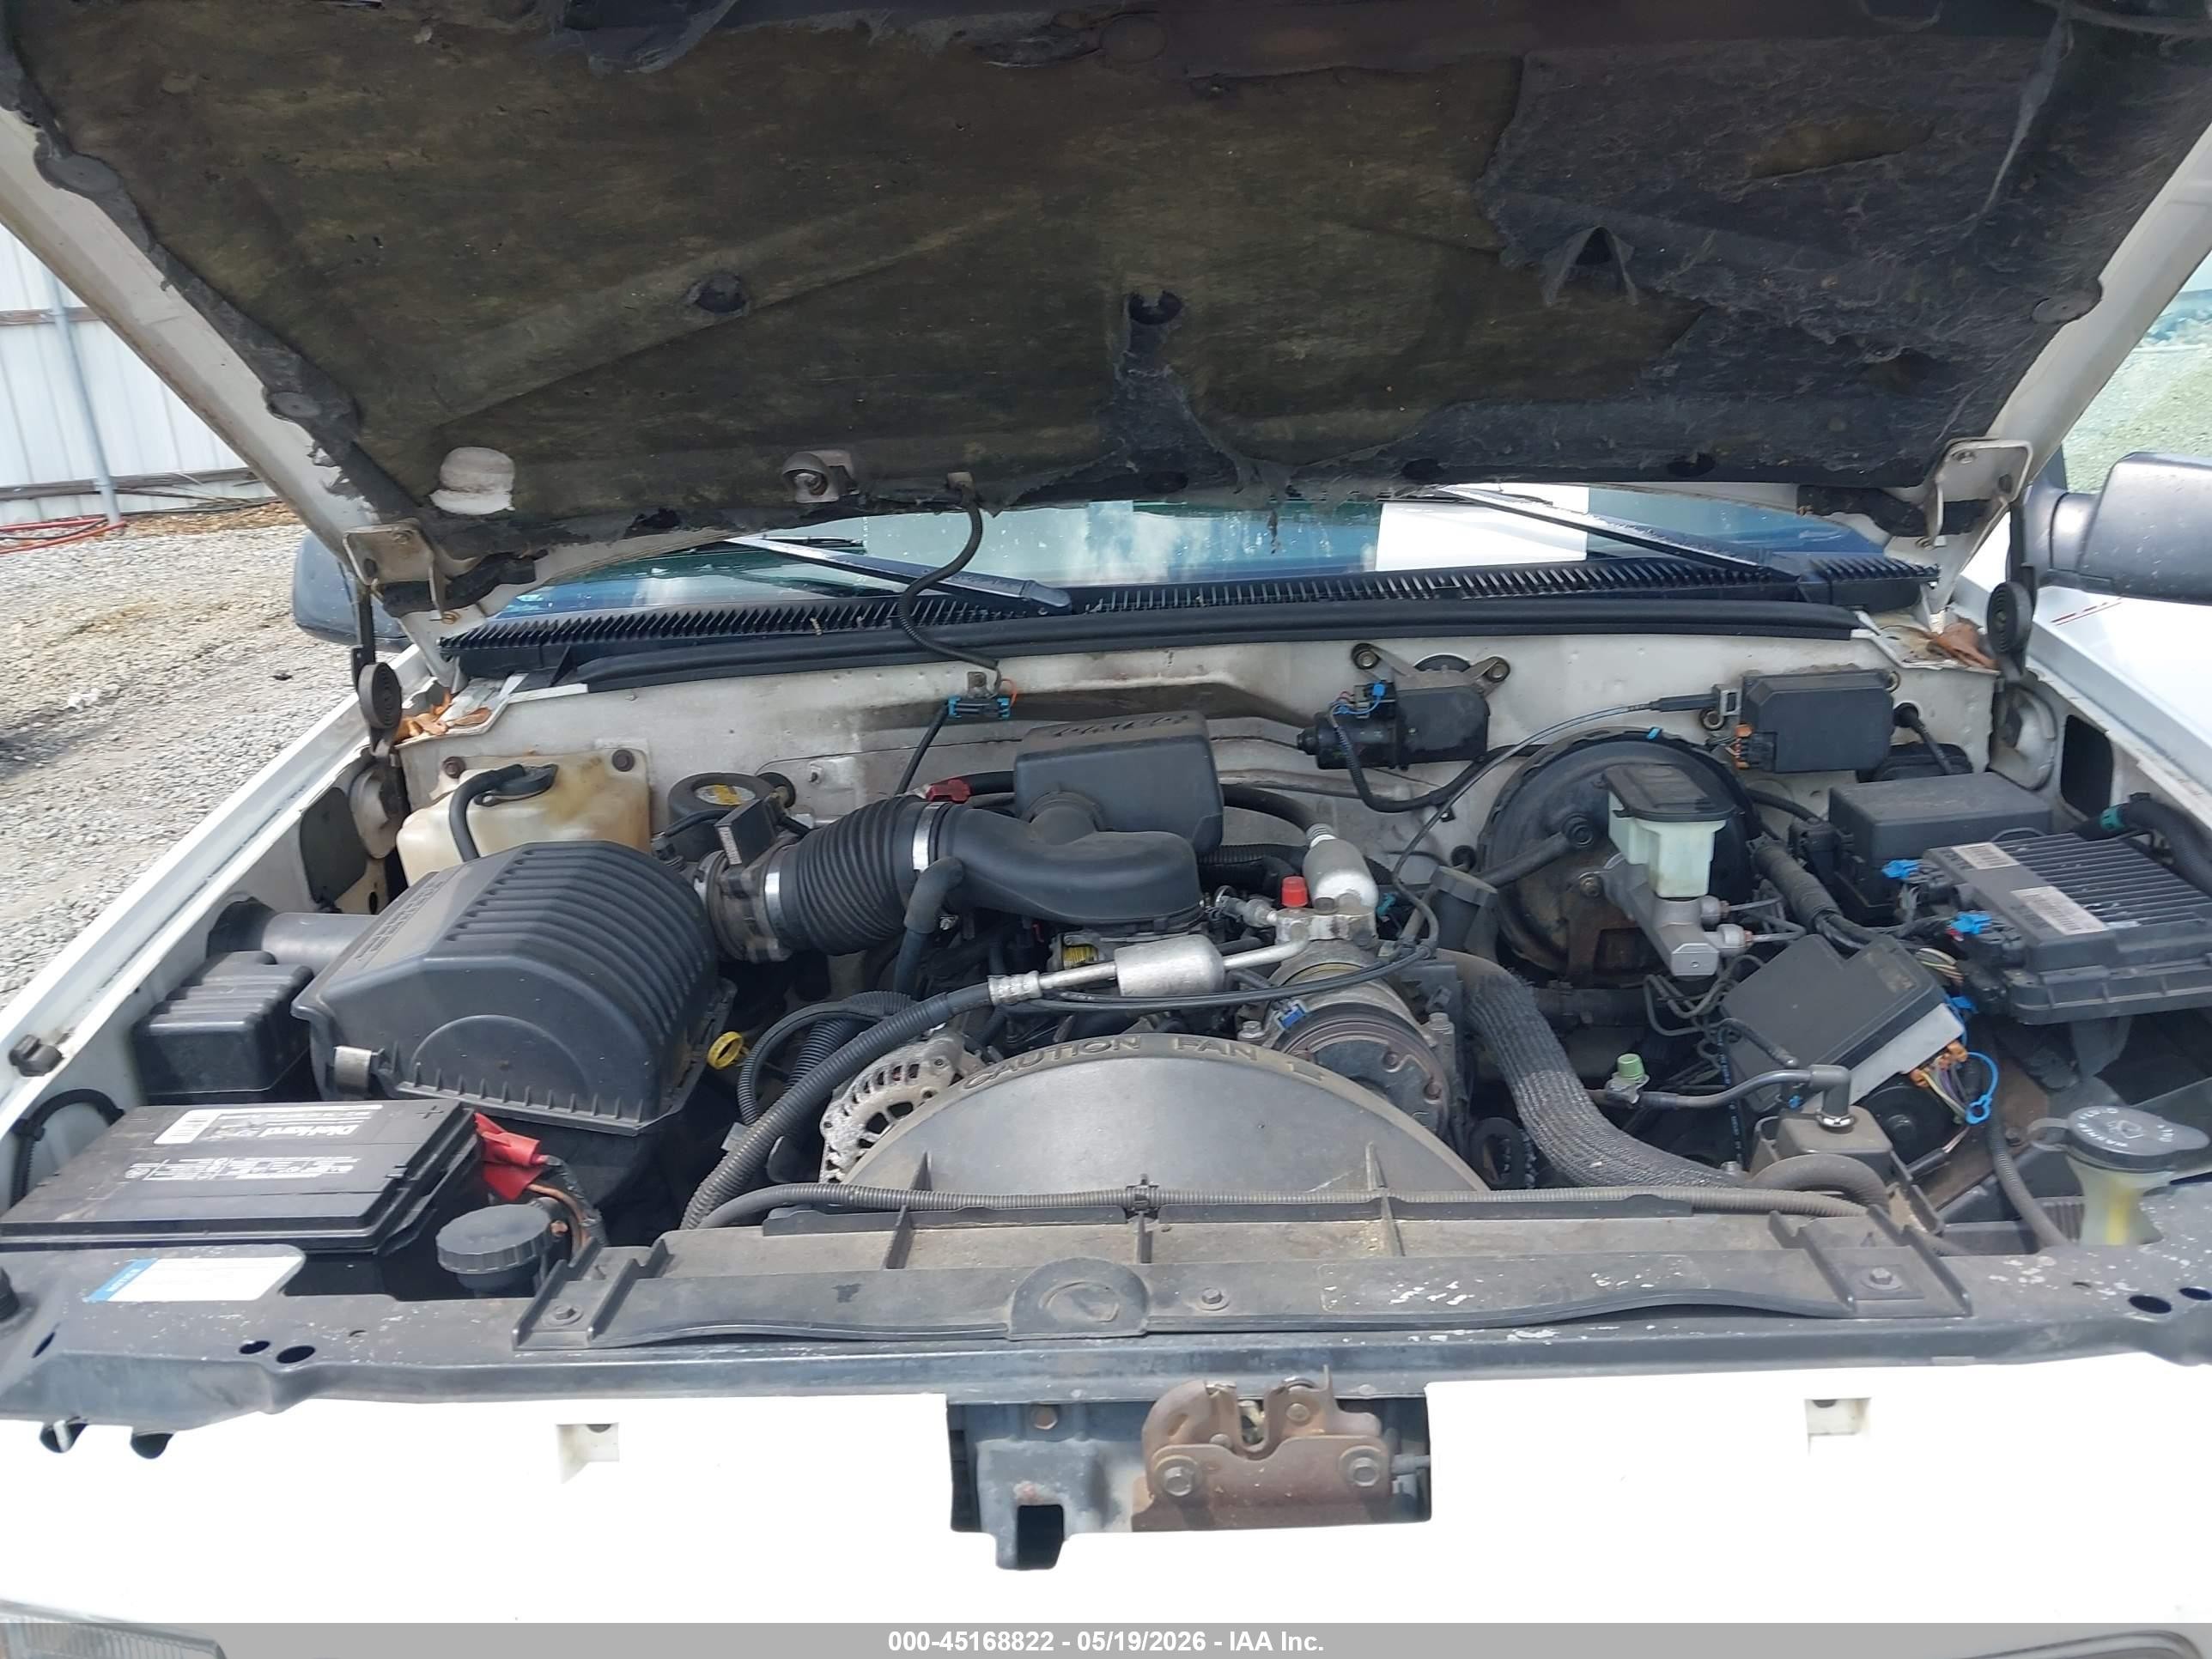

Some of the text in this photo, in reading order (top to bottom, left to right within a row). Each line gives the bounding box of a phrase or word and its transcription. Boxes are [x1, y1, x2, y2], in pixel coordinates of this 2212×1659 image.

[963, 1035, 1258, 1091] CAUTION FAN
[258, 1123, 360, 1139] DieHard
